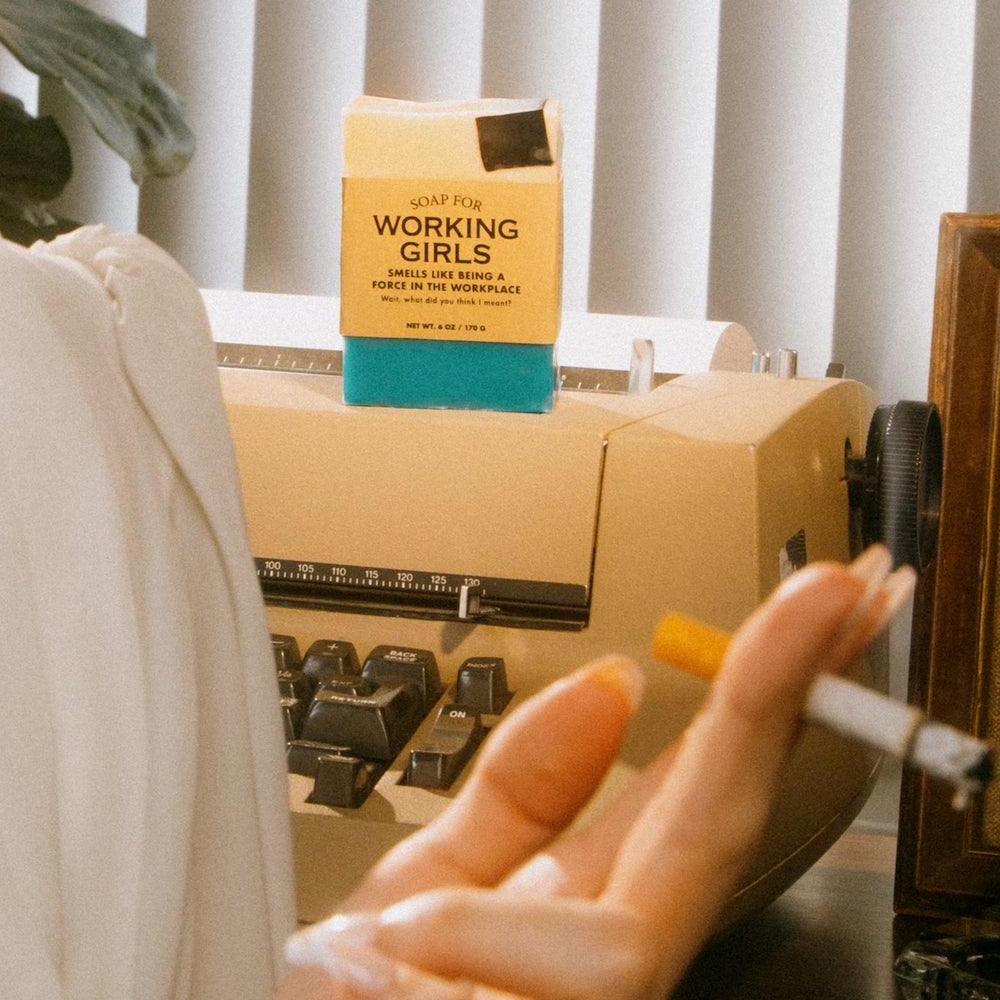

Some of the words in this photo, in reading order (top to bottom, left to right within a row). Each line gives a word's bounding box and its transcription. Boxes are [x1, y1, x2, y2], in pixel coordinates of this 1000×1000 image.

[410, 194, 449, 210] SOAP
[453, 195, 482, 212] FOR
[373, 215, 519, 239] WORKING
[400, 241, 491, 264] GIRLS
[388, 269, 427, 279] SMELLS
[431, 270, 454, 280] LIKE
[458, 271, 493, 281] BEING
[497, 273, 505, 281] A
[372, 281, 406, 290] FORCE
[411, 282, 423, 291] IN
[427, 282, 447, 291] THE
[451, 284, 521, 294] WORKPLACE
[381, 295, 401, 304] Wait,
[404, 296, 422, 304] what
[425, 296, 438, 304] did
[456, 297, 475, 305] think
[265, 561, 281, 571] 100
[298, 564, 314, 573] 105
[332, 567, 347, 576] 110
[365, 570, 379, 579] 115
[397, 573, 413, 582] 120
[430, 575, 447, 584] 125
[464, 578, 480, 586] 130
[389, 650, 418, 658] BACK
